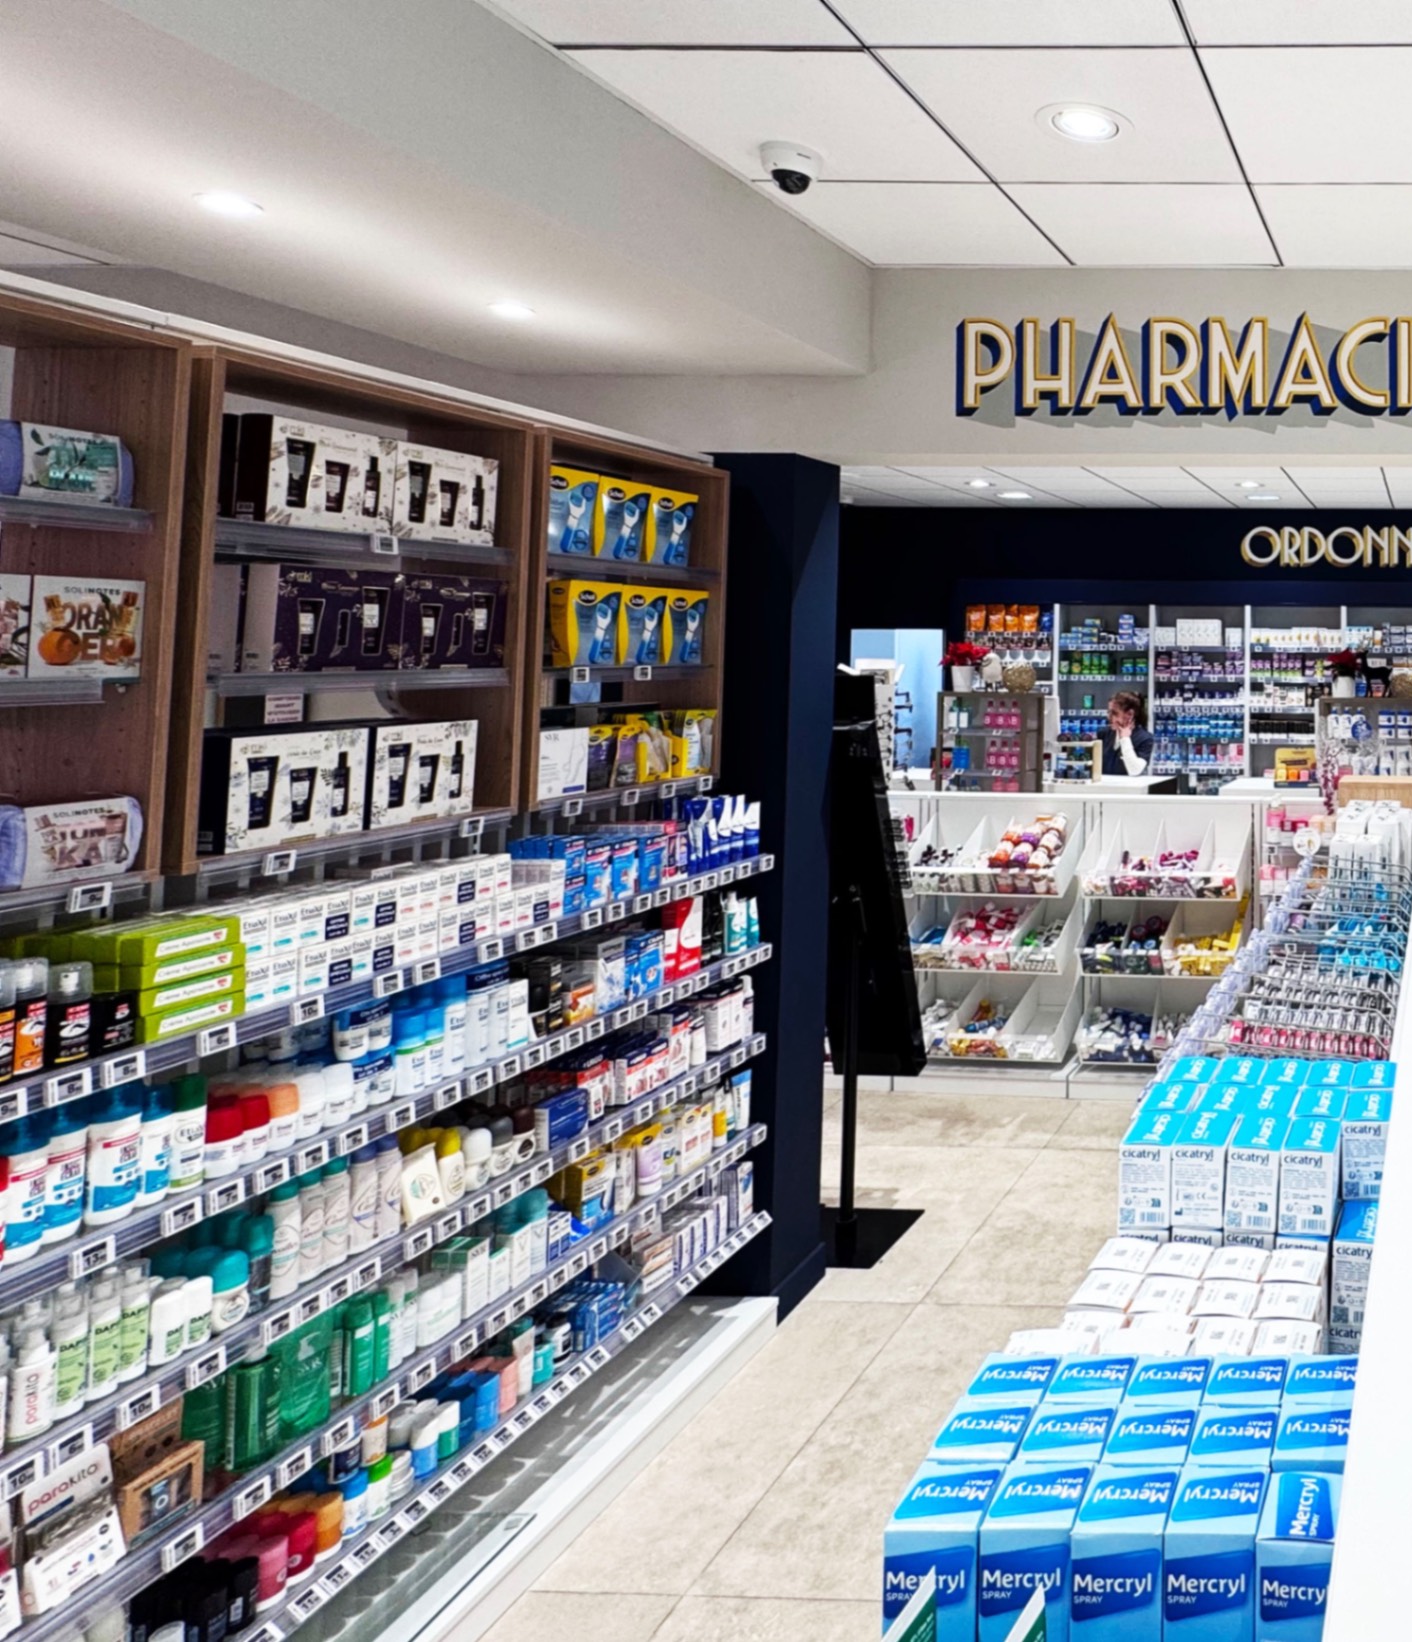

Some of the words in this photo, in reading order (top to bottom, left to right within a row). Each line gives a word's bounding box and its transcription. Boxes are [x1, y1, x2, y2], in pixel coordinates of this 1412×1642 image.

[63, 586, 121, 596] SOLINOTES
[53, 806, 106, 819] SOLINOTES
[1344, 1124, 1382, 1137] cicatryl
[1121, 1149, 1161, 1162] cicatryl
[1175, 1148, 1214, 1162] cicatryl
[1230, 1151, 1270, 1165] cicatryl
[1283, 1154, 1323, 1168] cicatryl
[1226, 1233, 1265, 1247] cicatryl
[981, 1368, 1049, 1382] Mercryl
[1062, 1367, 1128, 1381] Mercryl
[1139, 1367, 1206, 1382] Mercryl
[1217, 1367, 1282, 1382] Mercryl
[951, 1417, 1022, 1433] Mercryl
[1035, 1420, 1107, 1435] Mercryl
[1119, 1422, 1190, 1438] Mercryl
[1202, 1423, 1272, 1439] Mercryl
[27, 1463, 99, 1516] parakito
[911, 1483, 990, 1501] Mercryl
[1004, 1482, 1083, 1500] Mercryl
[1092, 1485, 1171, 1503] Mercryl
[1184, 1486, 1260, 1503] Mercryl
[1288, 1477, 1320, 1537] Mercryl
[885, 1569, 965, 1594] Merryl
[982, 1567, 1061, 1592] Mercryl
[1073, 1572, 1152, 1597] Mercryl
[1167, 1573, 1246, 1597] Mercryl
[982, 1590, 1012, 1600] SPRAY
[1073, 1595, 1103, 1604] SPRAY
[1167, 1595, 1197, 1604] SPRAY
[1262, 1598, 1288, 1608] SPRAY
